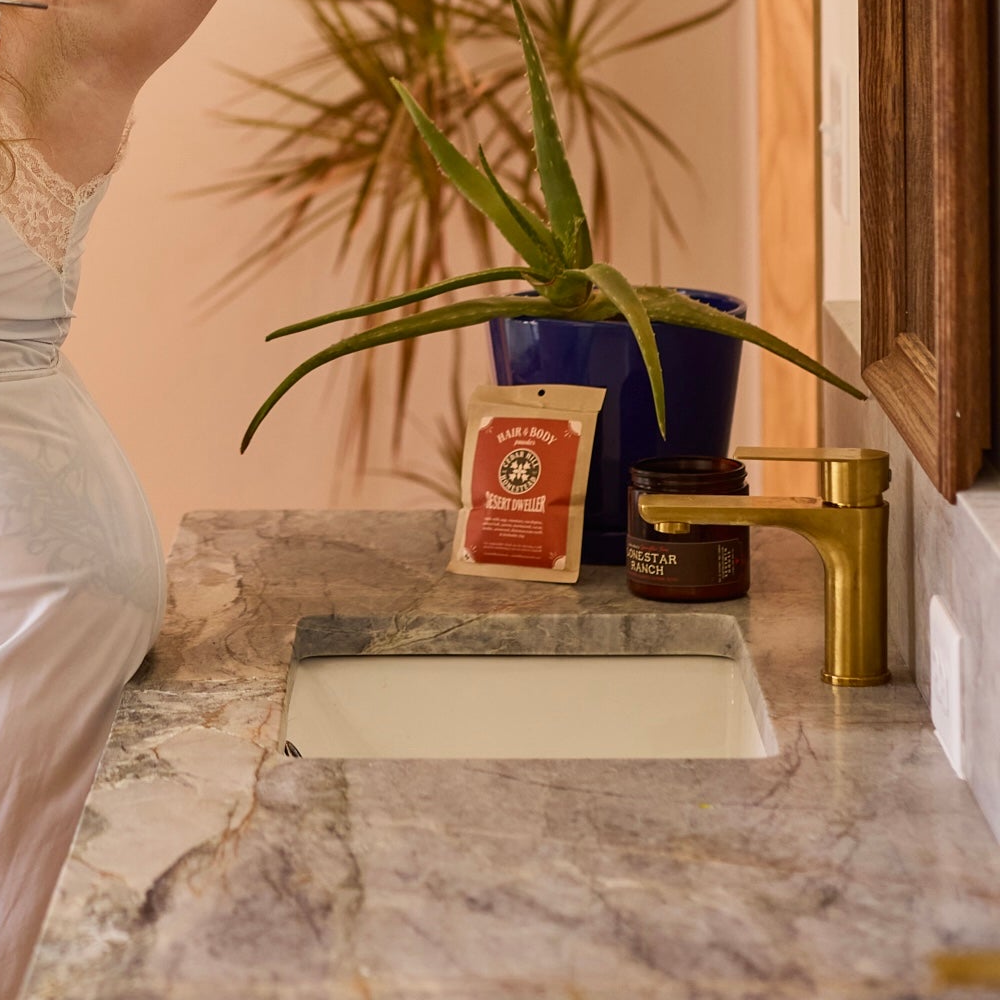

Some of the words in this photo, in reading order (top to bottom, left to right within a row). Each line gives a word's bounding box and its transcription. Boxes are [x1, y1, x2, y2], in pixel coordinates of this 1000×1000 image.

[497, 427, 522, 443] HAIR
[530, 427, 557, 445] BODY
[503, 451, 525, 468] CEDAR
[512, 495, 546, 514] DWELLER
[630, 560, 664, 576] RANCH
